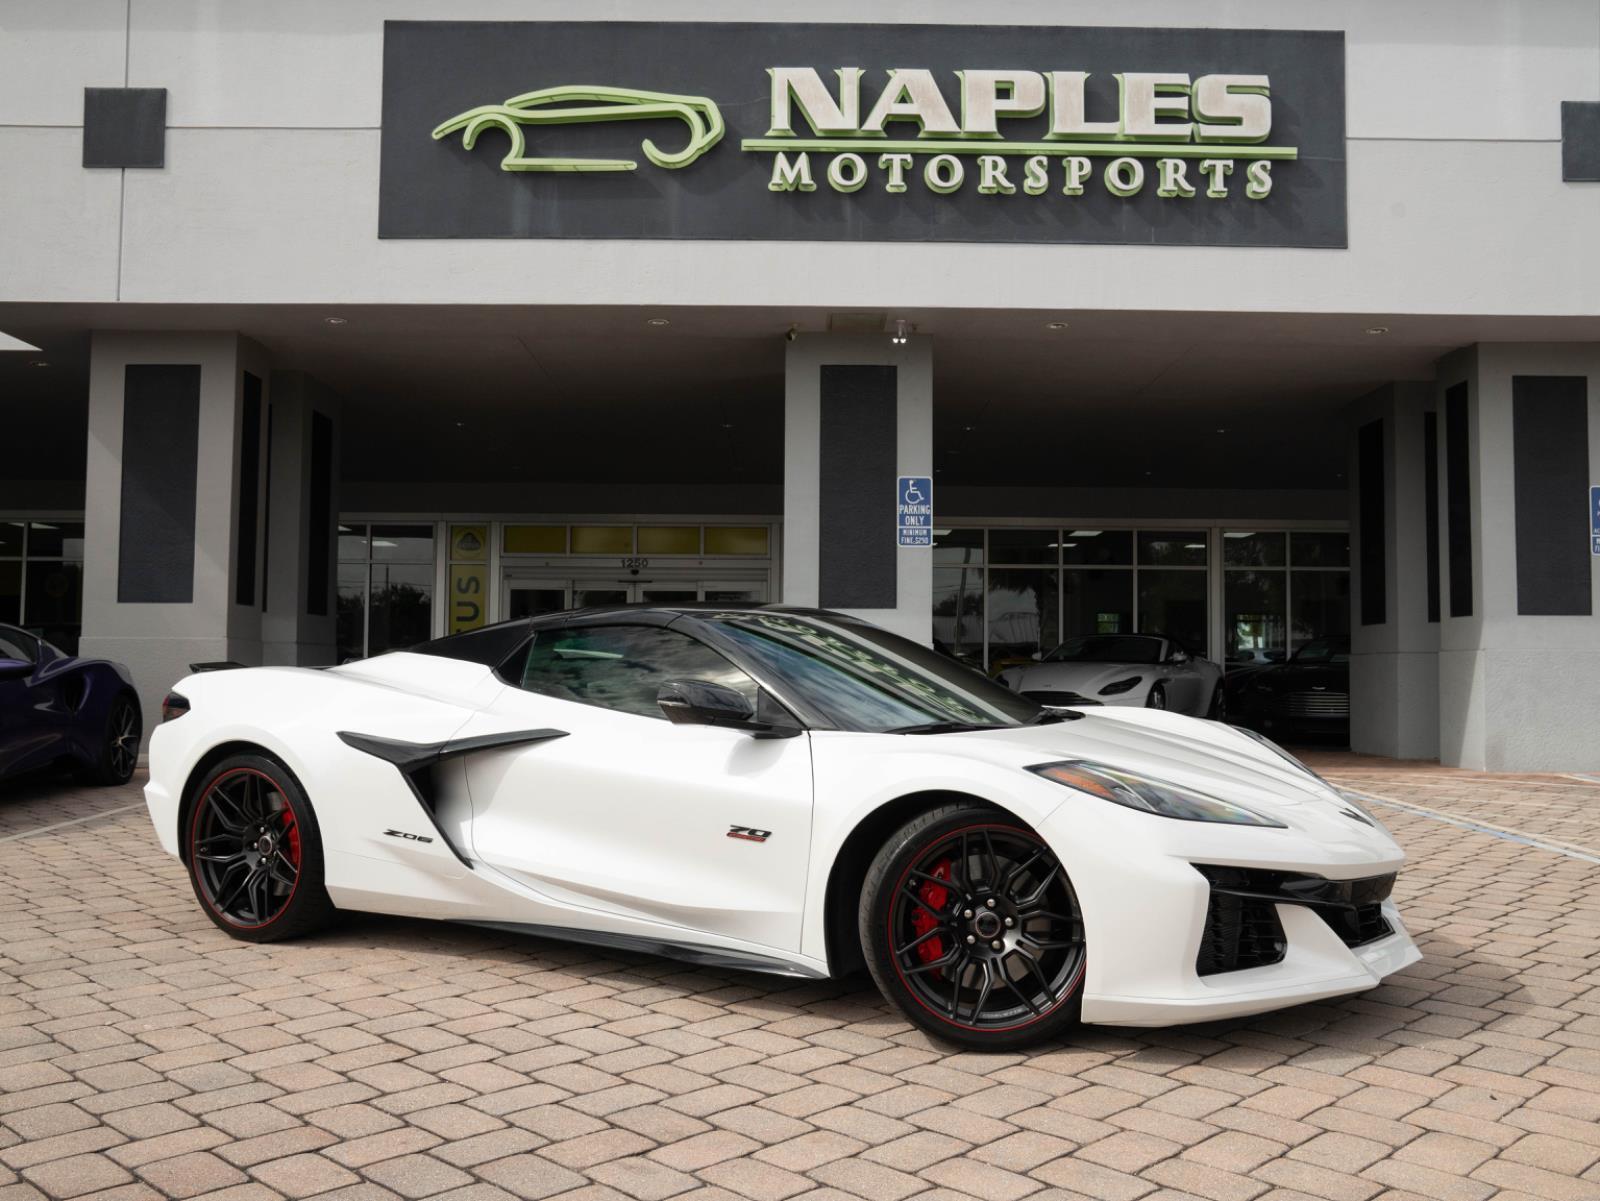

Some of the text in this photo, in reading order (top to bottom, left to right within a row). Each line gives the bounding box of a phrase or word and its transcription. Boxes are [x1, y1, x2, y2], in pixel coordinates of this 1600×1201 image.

[765, 66, 1272, 143] NAPLES
[767, 151, 1273, 199] MOTORSPORTS
[899, 505, 930, 514] PARKING
[905, 515, 924, 525] ONLY
[621, 558, 649, 568] 1250
[382, 828, 433, 843] Z06
